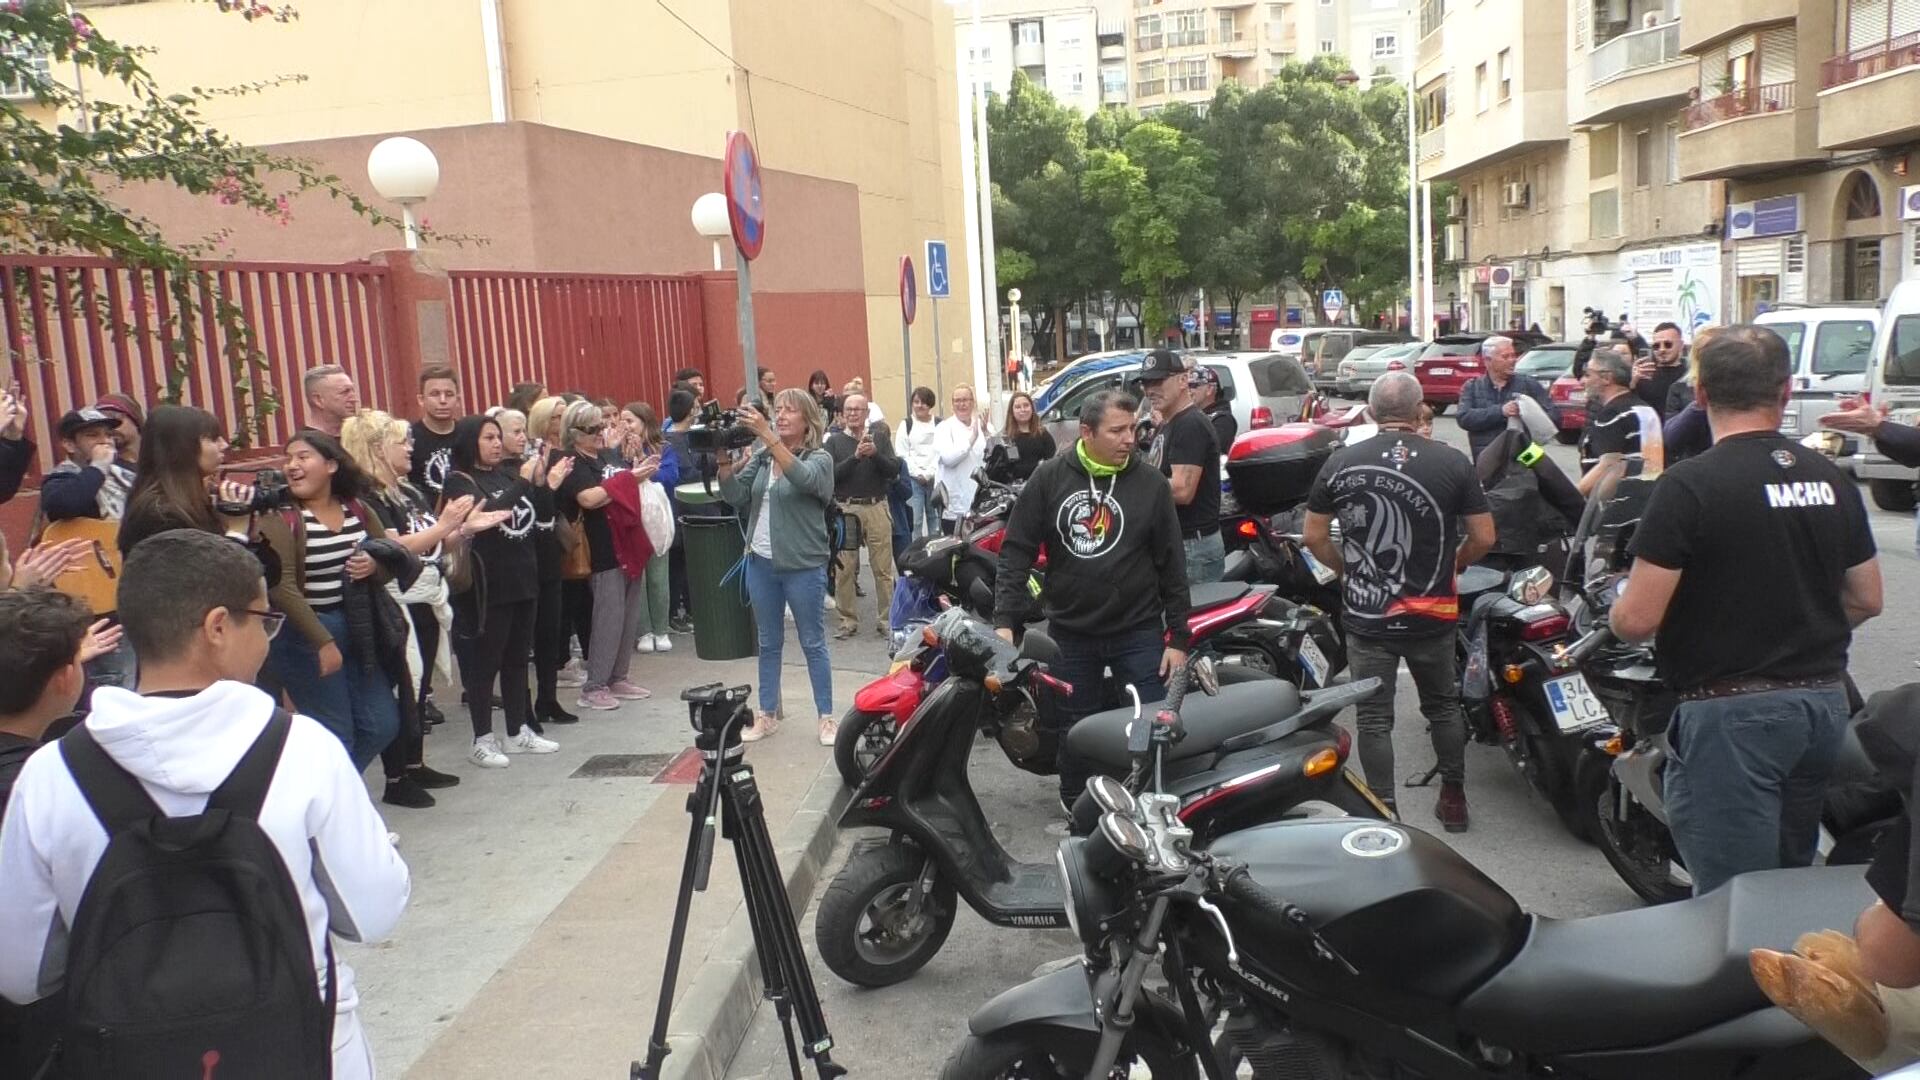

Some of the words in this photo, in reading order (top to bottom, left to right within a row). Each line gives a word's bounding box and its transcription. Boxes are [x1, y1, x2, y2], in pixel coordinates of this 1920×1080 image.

[1764, 481, 1836, 508] NACHO
[1569, 698, 1606, 721] LC
[1010, 915, 1057, 926] YAMAHA
